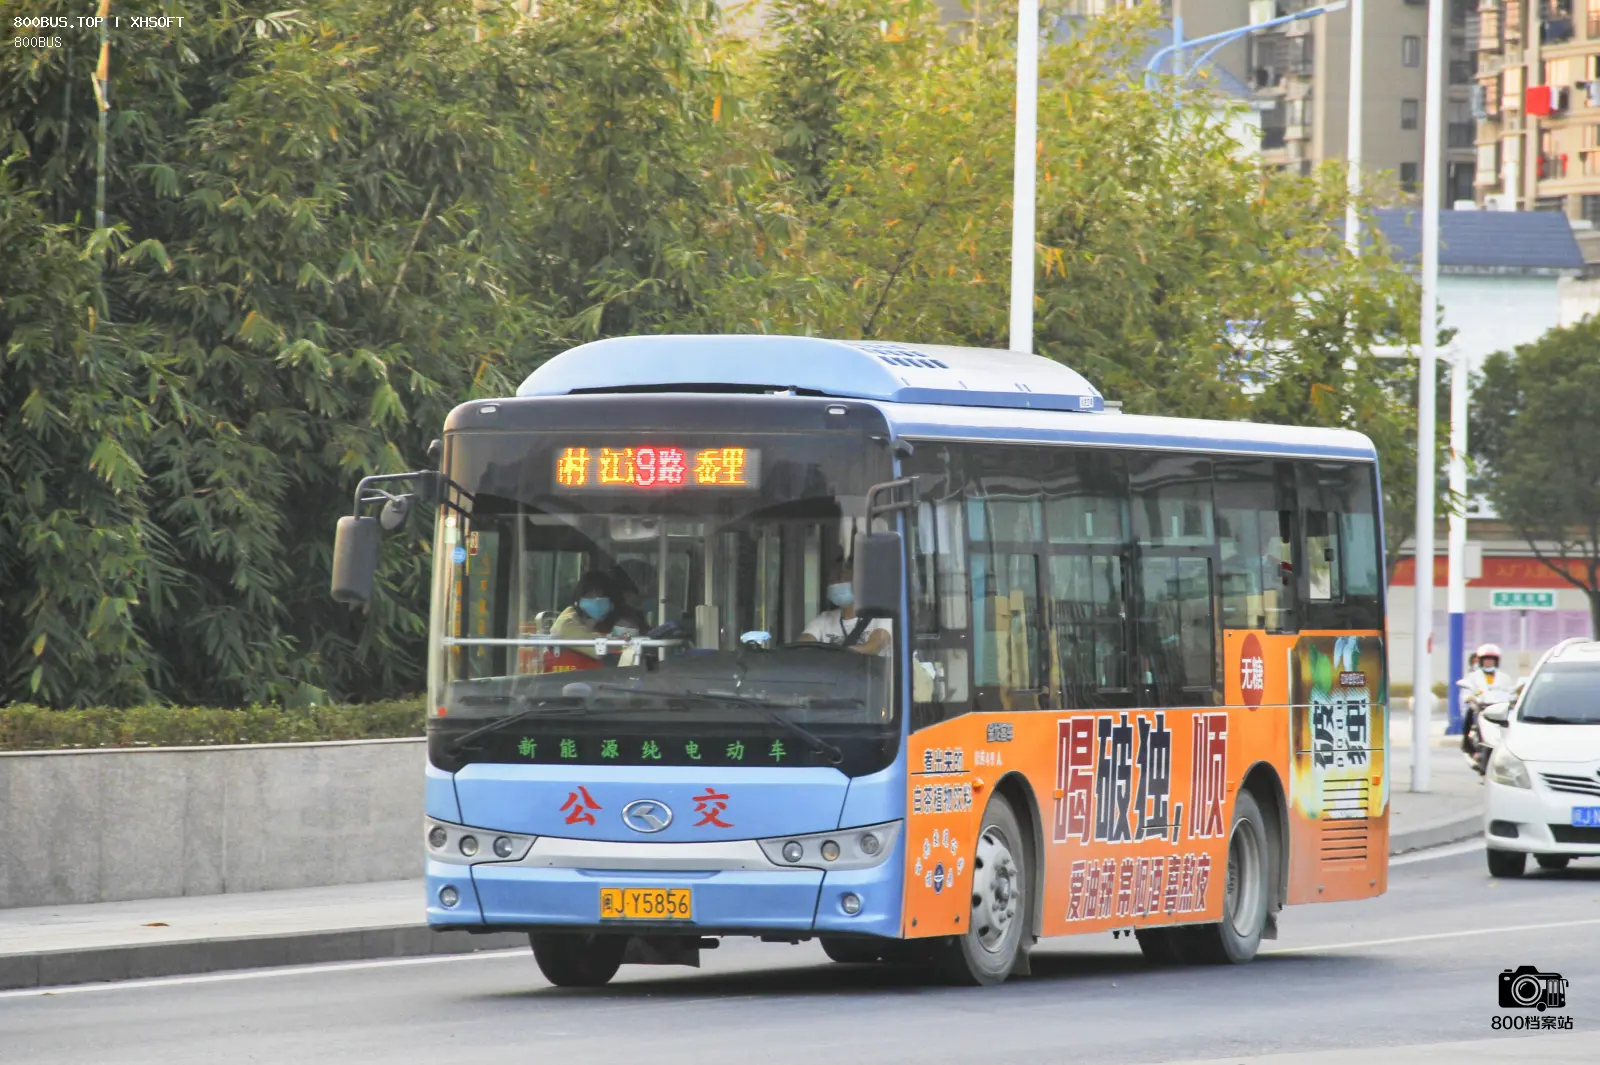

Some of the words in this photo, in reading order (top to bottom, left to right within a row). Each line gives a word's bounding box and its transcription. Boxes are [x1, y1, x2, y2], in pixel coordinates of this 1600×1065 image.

[1241, 656, 1264, 691] 无糖
[518, 736, 787, 762] 新能源纯电动车
